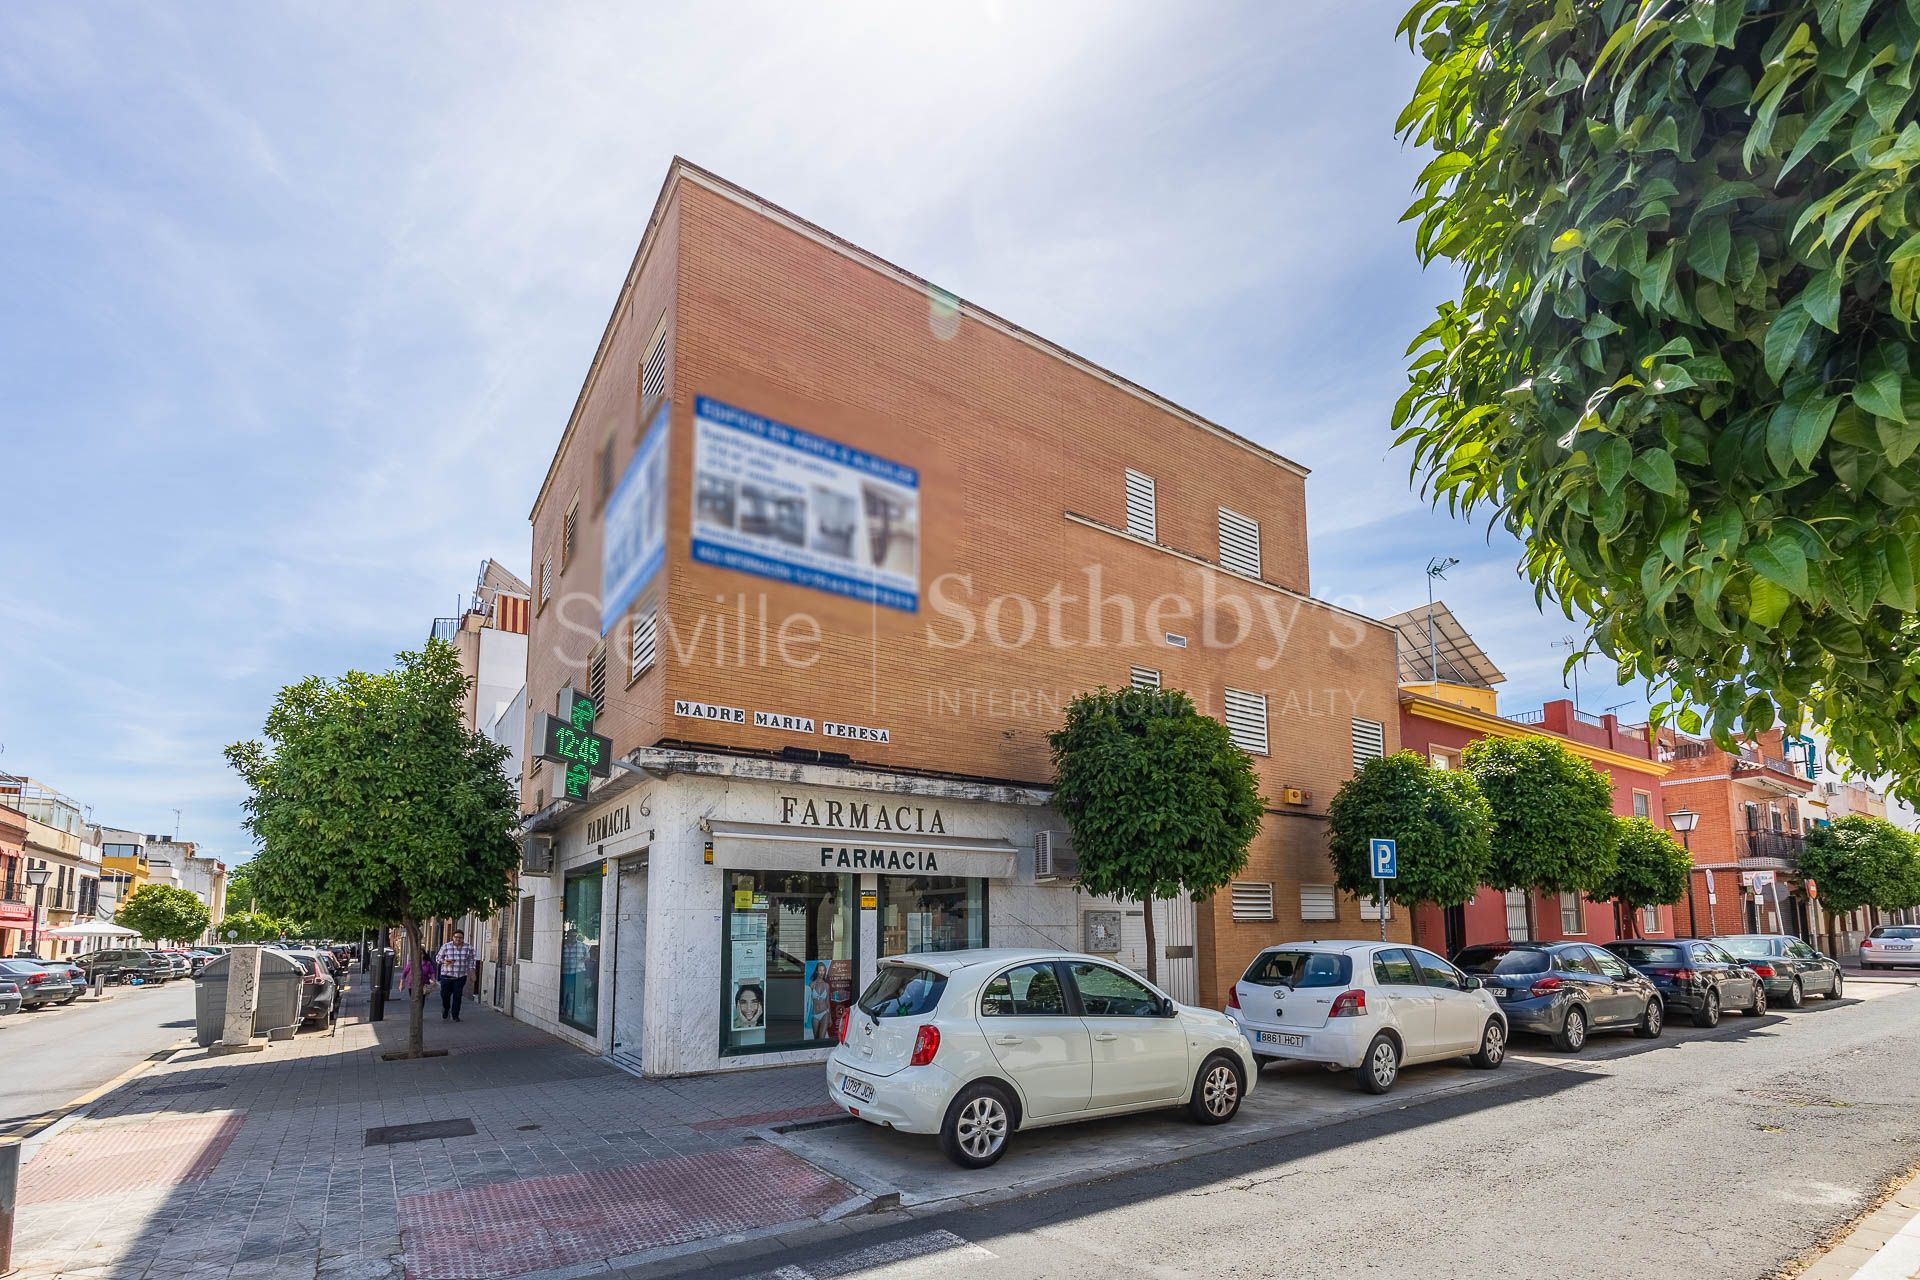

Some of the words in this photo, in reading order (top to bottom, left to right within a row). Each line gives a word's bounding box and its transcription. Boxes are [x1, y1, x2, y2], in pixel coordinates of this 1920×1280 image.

[675, 701, 745, 722] MADRE
[755, 712, 814, 733] MARIA
[824, 723, 889, 744] TERESA
[555, 727, 600, 766] 12:45
[586, 804, 631, 846] FARMACIA
[780, 796, 946, 834] FARMACIA
[820, 847, 938, 871] FARMACIA
[1377, 844, 1391, 873] P
[1261, 1032, 1281, 1043] 8861
[1284, 1035, 1300, 1046] HCT
[860, 1084, 875, 1100] JCH
